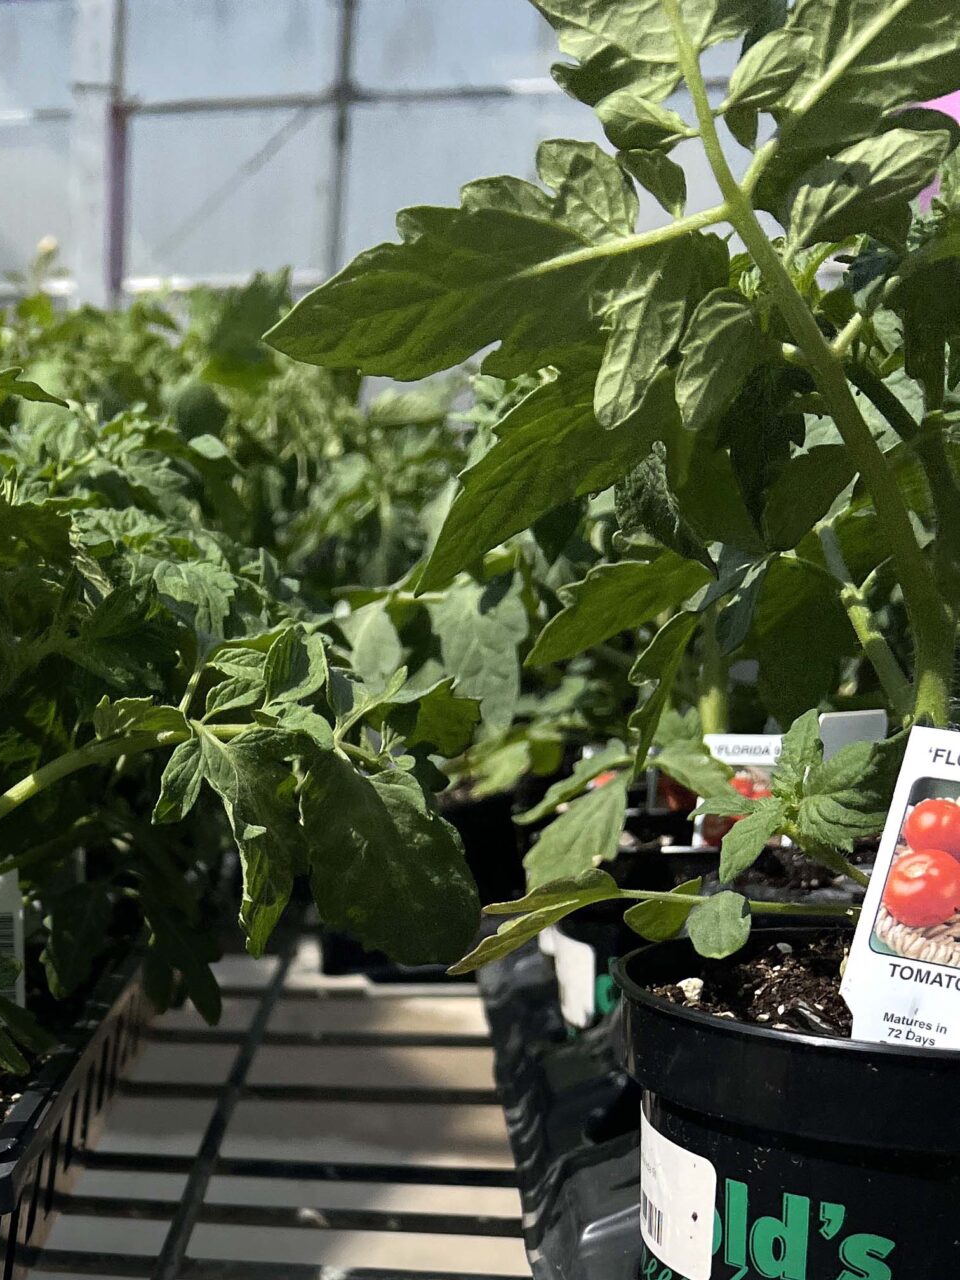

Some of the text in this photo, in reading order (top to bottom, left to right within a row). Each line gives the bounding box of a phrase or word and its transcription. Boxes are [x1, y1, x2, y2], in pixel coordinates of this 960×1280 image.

[883, 1011, 948, 1035] Matures in
[887, 1027, 936, 1047] 72 Days
